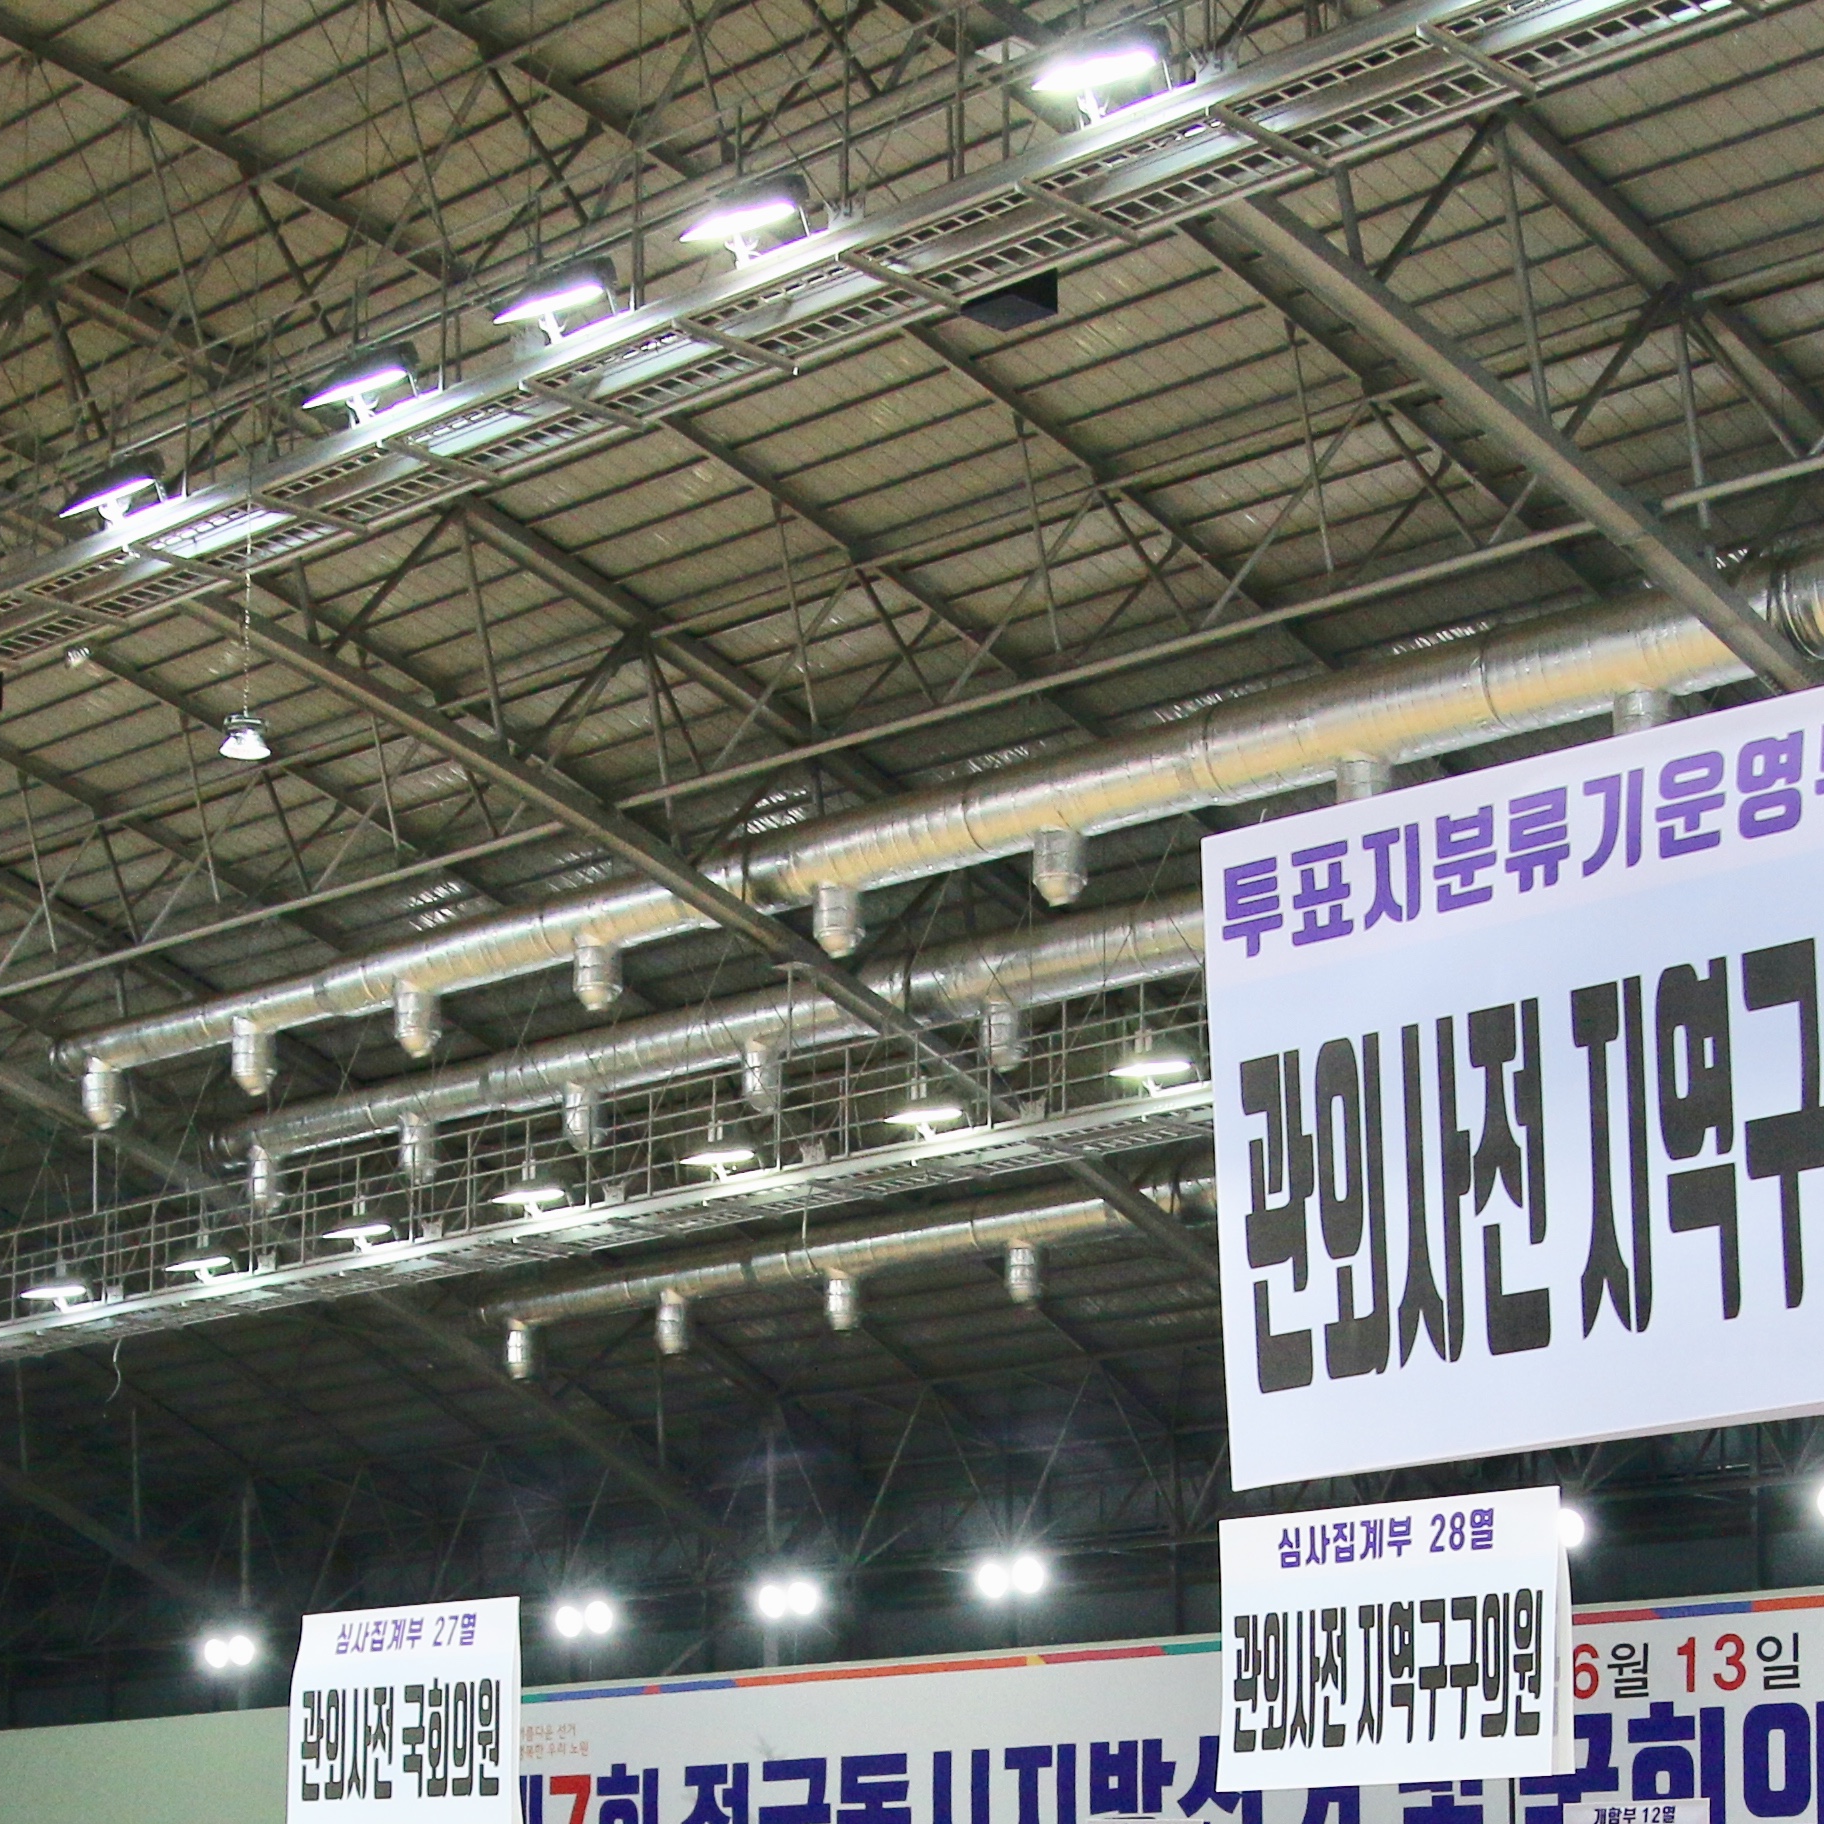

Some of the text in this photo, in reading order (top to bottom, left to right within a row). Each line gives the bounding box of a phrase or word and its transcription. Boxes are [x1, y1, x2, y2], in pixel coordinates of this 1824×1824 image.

[1239, 996, 1553, 1395] 관외사전
[1277, 1507, 1494, 1569] 심사집계부 28열
[335, 1613, 477, 1655] 심사집계부 27열
[1676, 1632, 1802, 1692] 13일
[1232, 1588, 1543, 1754] 관외사전 지역구구의원
[301, 1677, 501, 1801] 관외사전 국회의원
[1643, 1805, 1676, 1823] 12열
